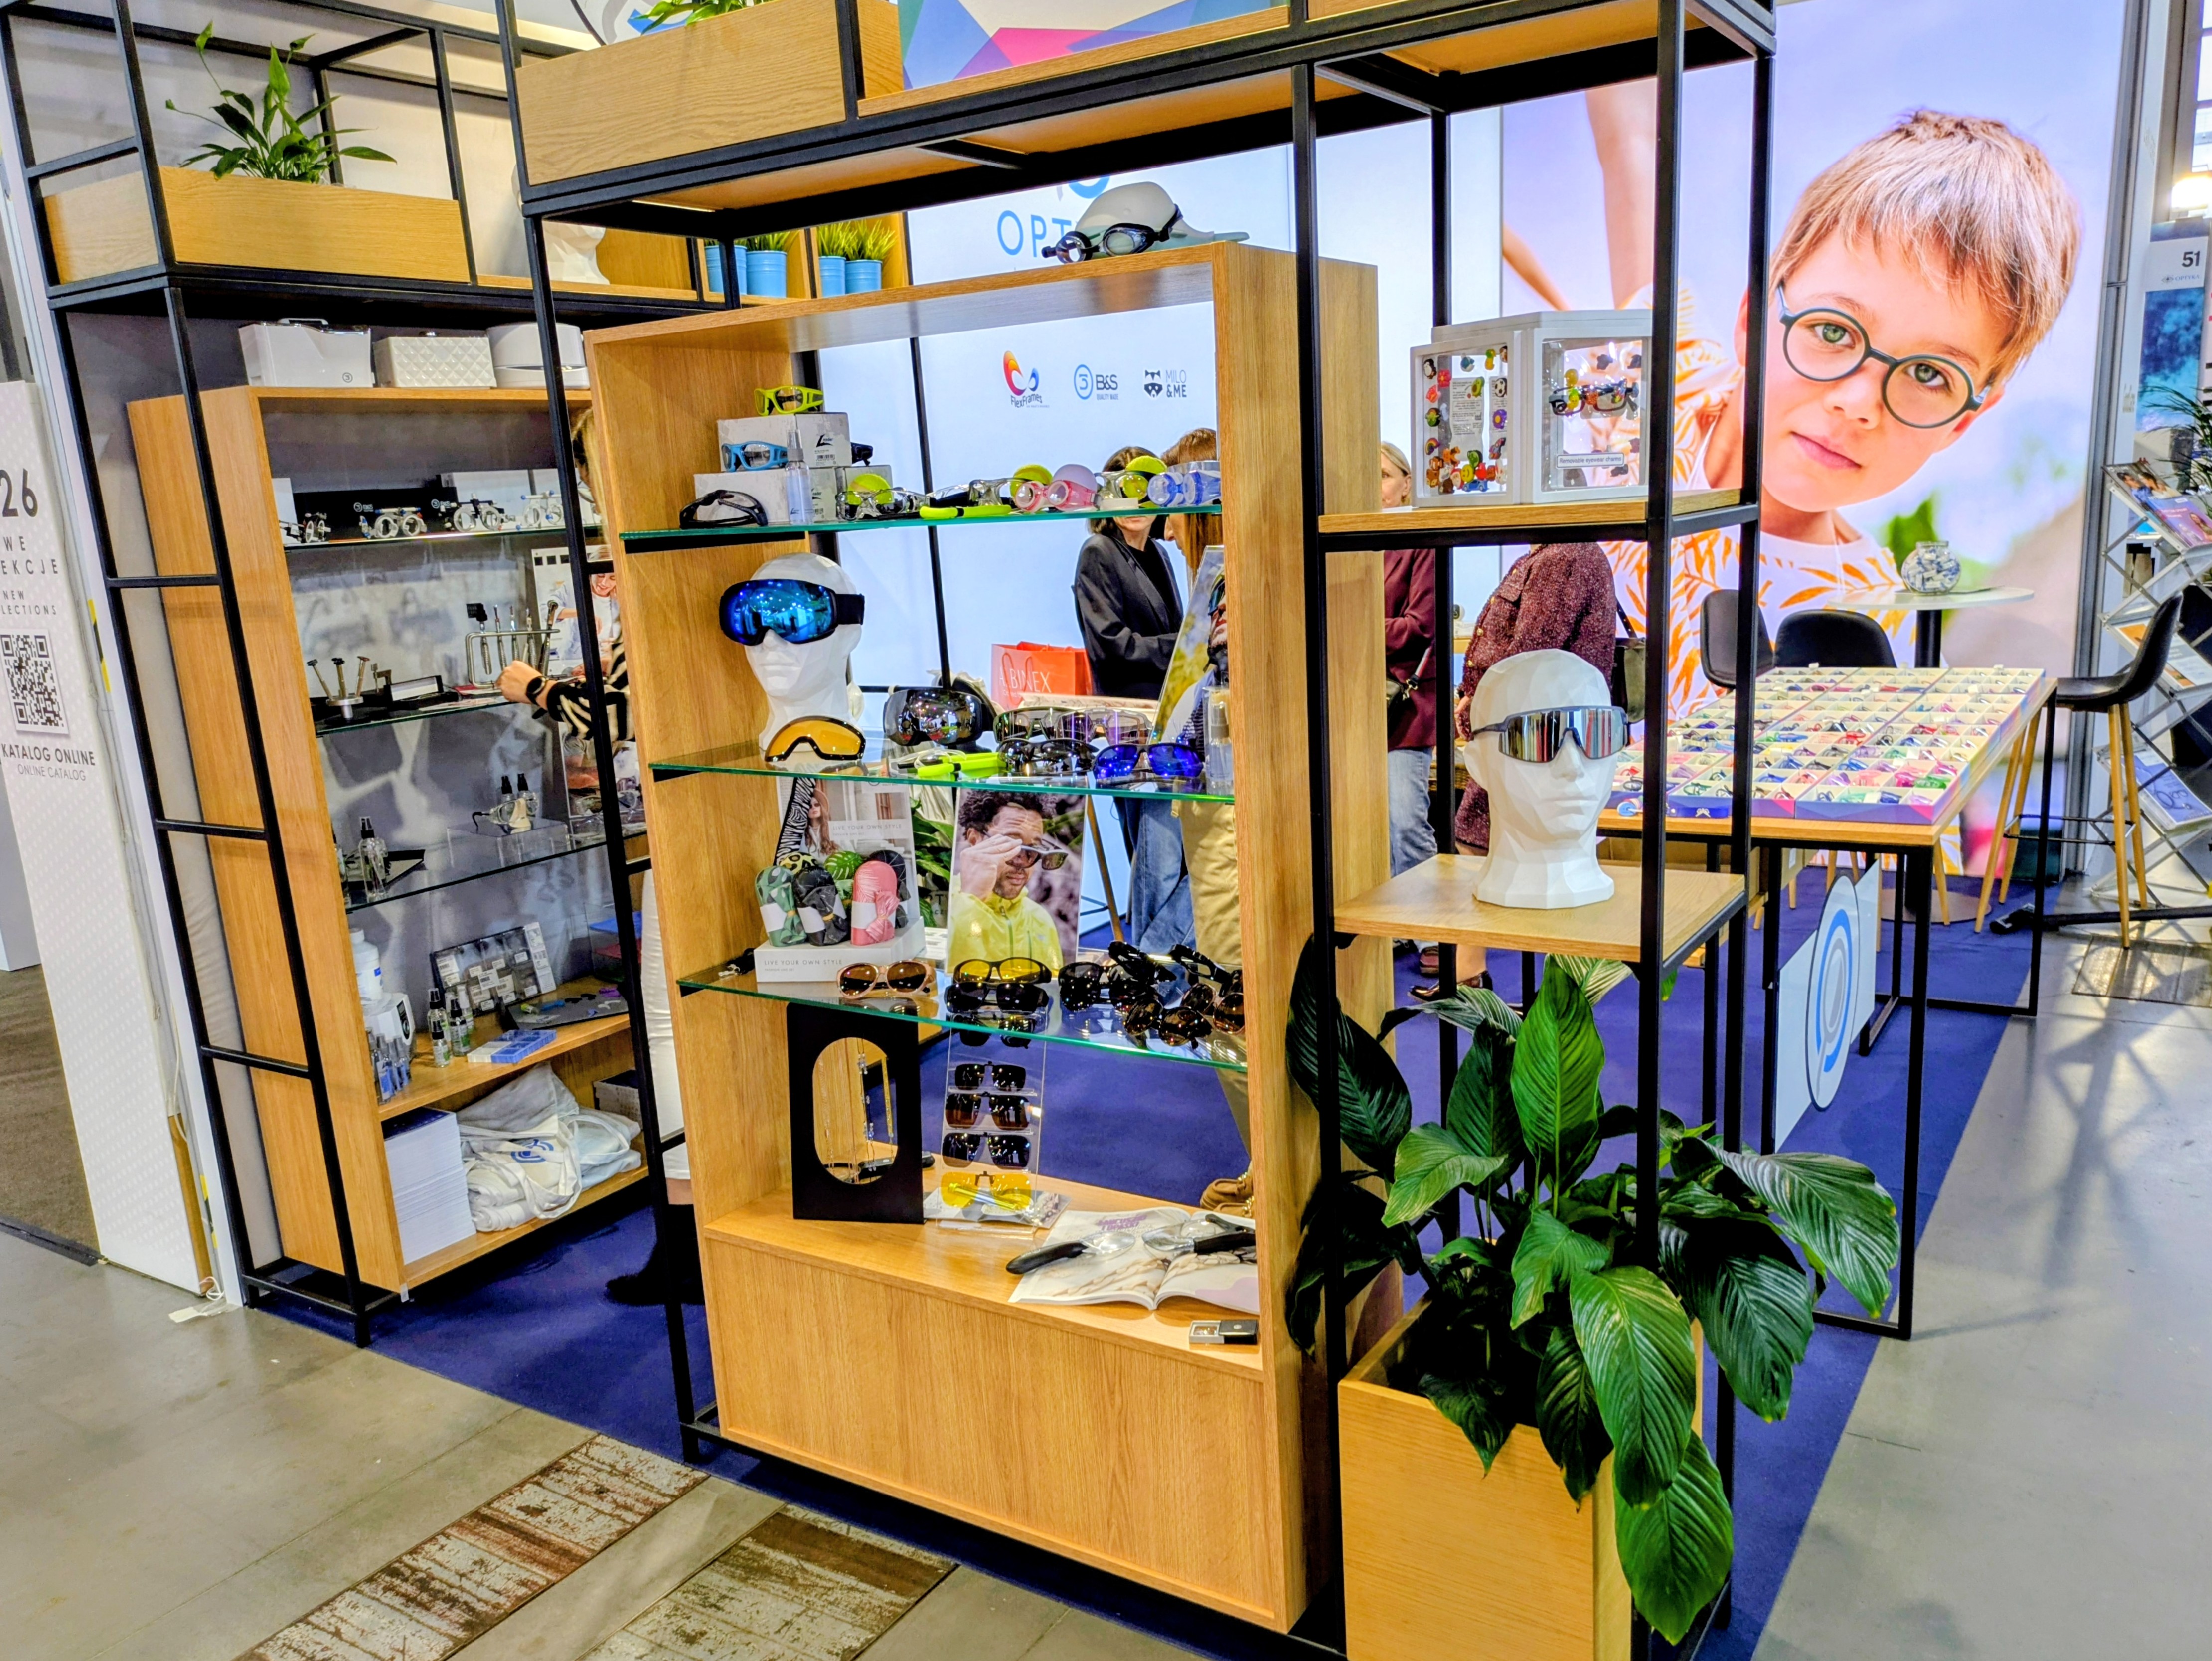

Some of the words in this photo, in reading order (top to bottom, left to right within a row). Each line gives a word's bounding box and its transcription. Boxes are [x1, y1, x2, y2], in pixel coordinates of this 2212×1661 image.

[2182, 251, 2200, 267] 51
[1096, 374, 1118, 390] B&S
[1166, 369, 1186, 383] MILO
[1166, 384, 1187, 398] &ME
[1010, 393, 1042, 408] FlexFrames
[3, 590, 24, 600] NEW
[999, 666, 1052, 693] ABINEX
[1, 743, 51, 761] KATALOG
[55, 748, 95, 766] ONLINE
[17, 764, 46, 777] ONLINE
[47, 767, 86, 781] CATALOG
